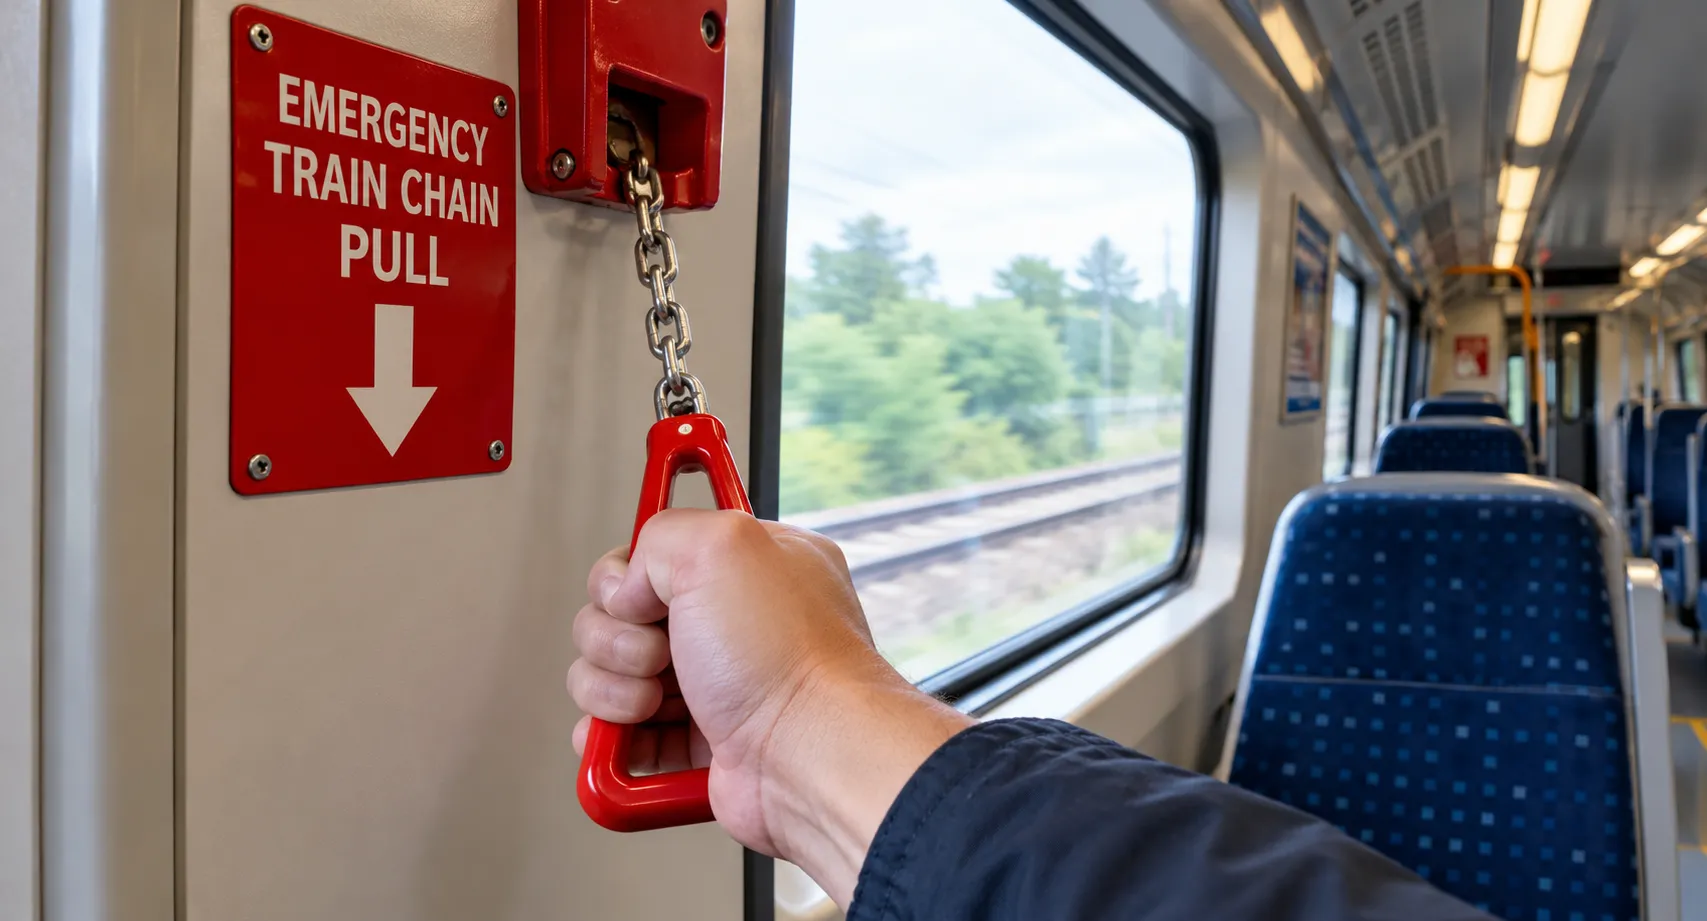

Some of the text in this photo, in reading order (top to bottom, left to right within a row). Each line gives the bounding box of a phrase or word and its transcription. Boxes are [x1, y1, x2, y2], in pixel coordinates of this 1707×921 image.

[279, 74, 488, 166] EMERGENCY
[264, 140, 498, 227] TRAIN CHAIN
[340, 223, 449, 287] PULL
